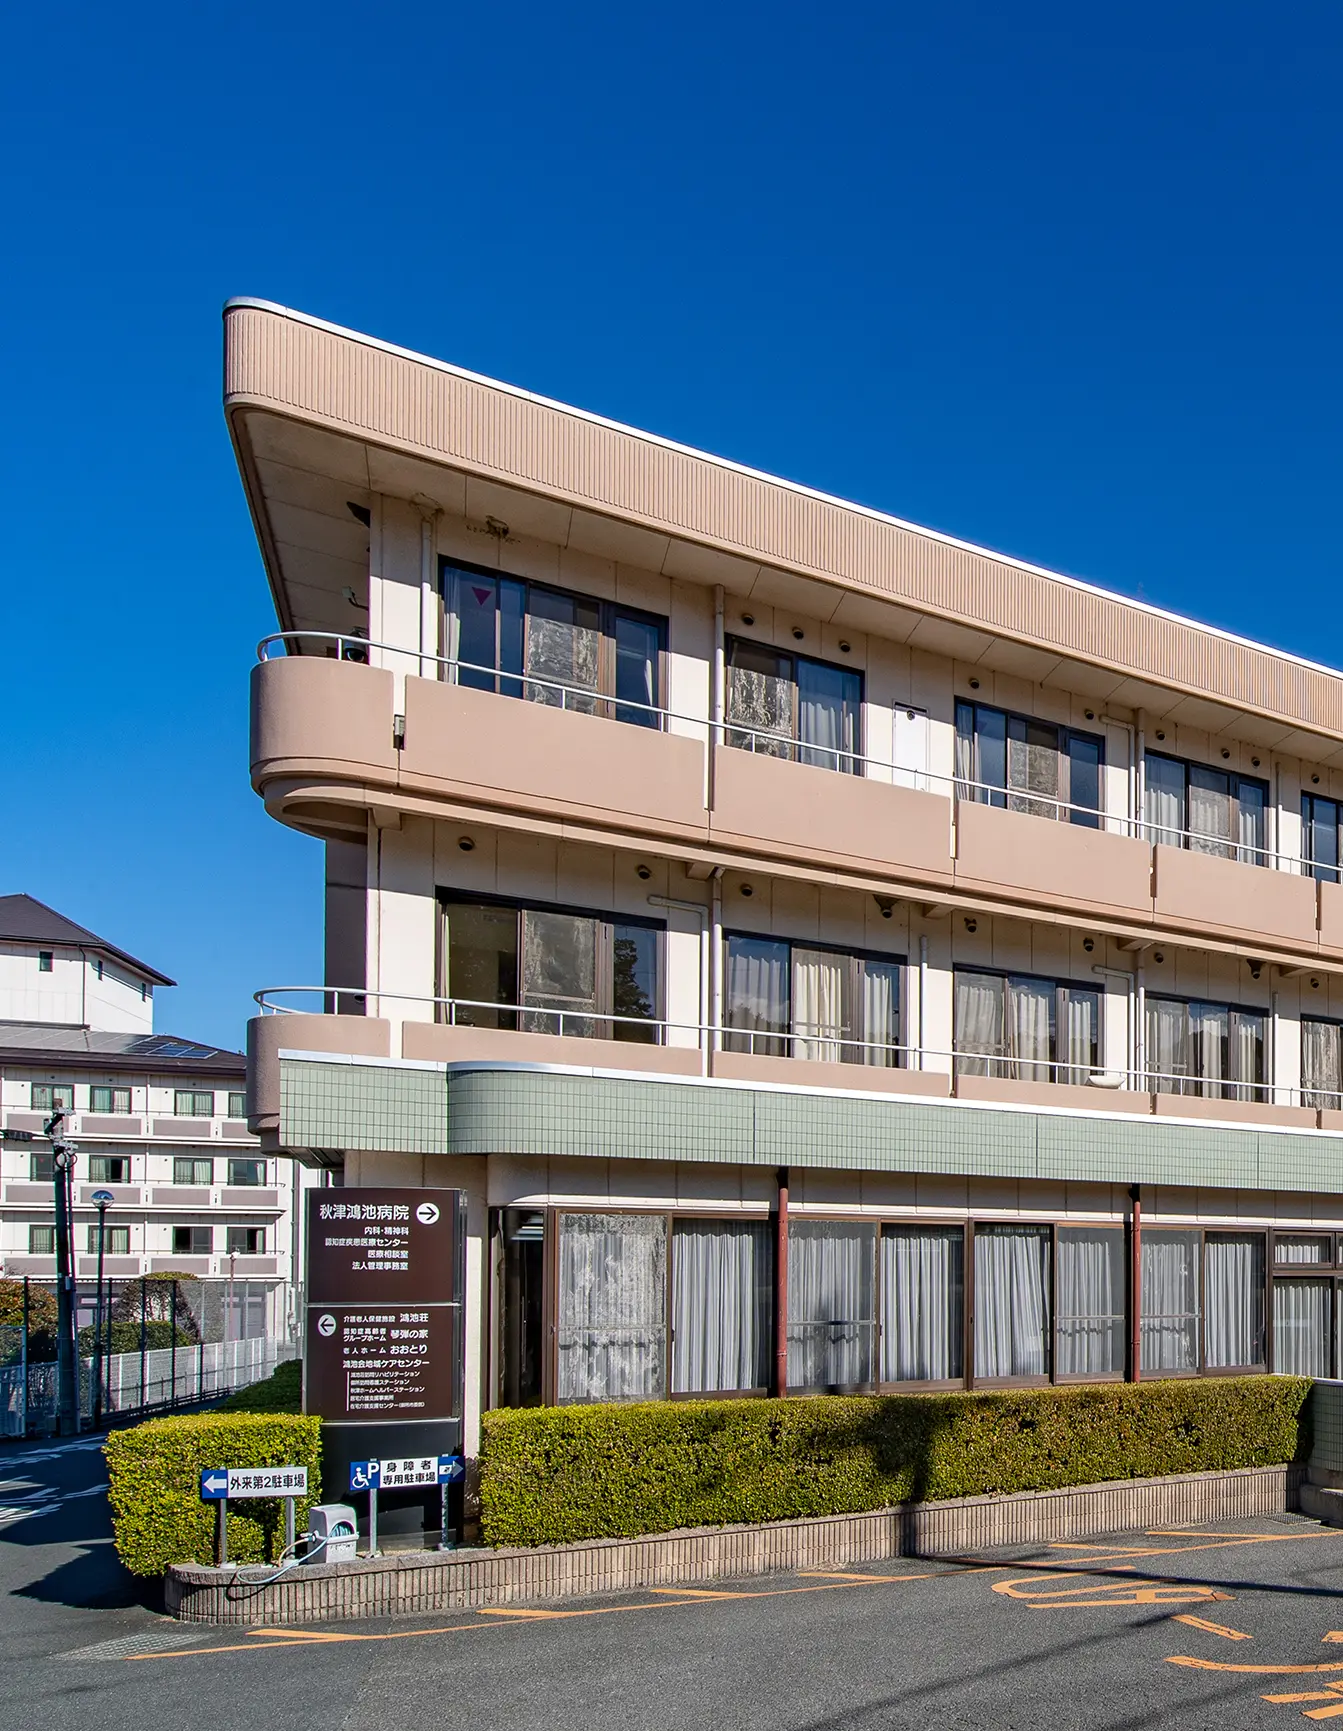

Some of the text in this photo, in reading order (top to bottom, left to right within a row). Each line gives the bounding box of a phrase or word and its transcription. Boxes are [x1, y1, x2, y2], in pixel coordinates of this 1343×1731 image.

[320, 1204, 410, 1220] 秋津鴻池病院
[390, 1344, 428, 1354] おおとり
[367, 1463, 379, 1479] P
[386, 1460, 432, 1473] 身障者
[230, 1474, 305, 1490] 外来第2駐車場
[382, 1471, 436, 1485] 専用駐車場
